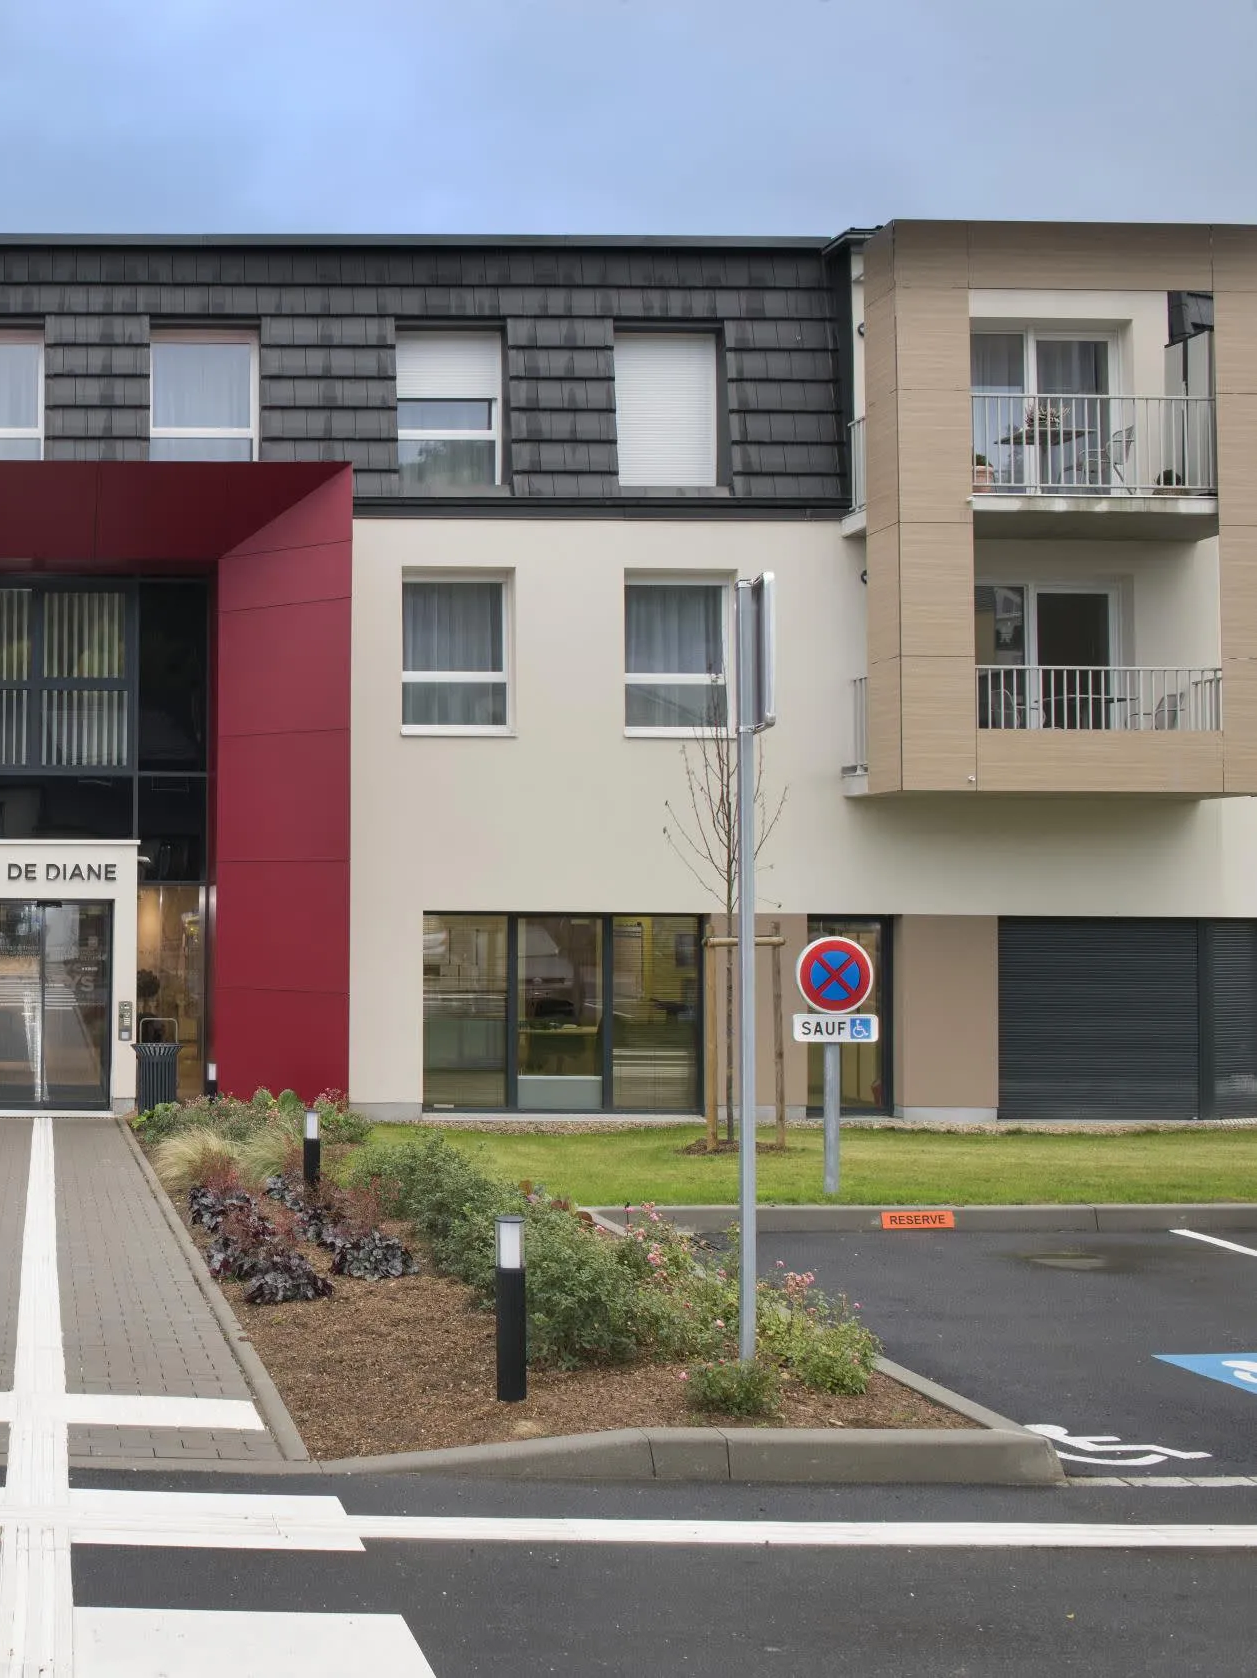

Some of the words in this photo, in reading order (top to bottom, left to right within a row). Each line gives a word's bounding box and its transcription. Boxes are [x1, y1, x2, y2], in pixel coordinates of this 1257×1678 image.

[7, 863, 37, 881] DE
[46, 863, 117, 881] DIANE
[801, 1021, 846, 1036] SAUF
[889, 1214, 945, 1225] RESERVE
